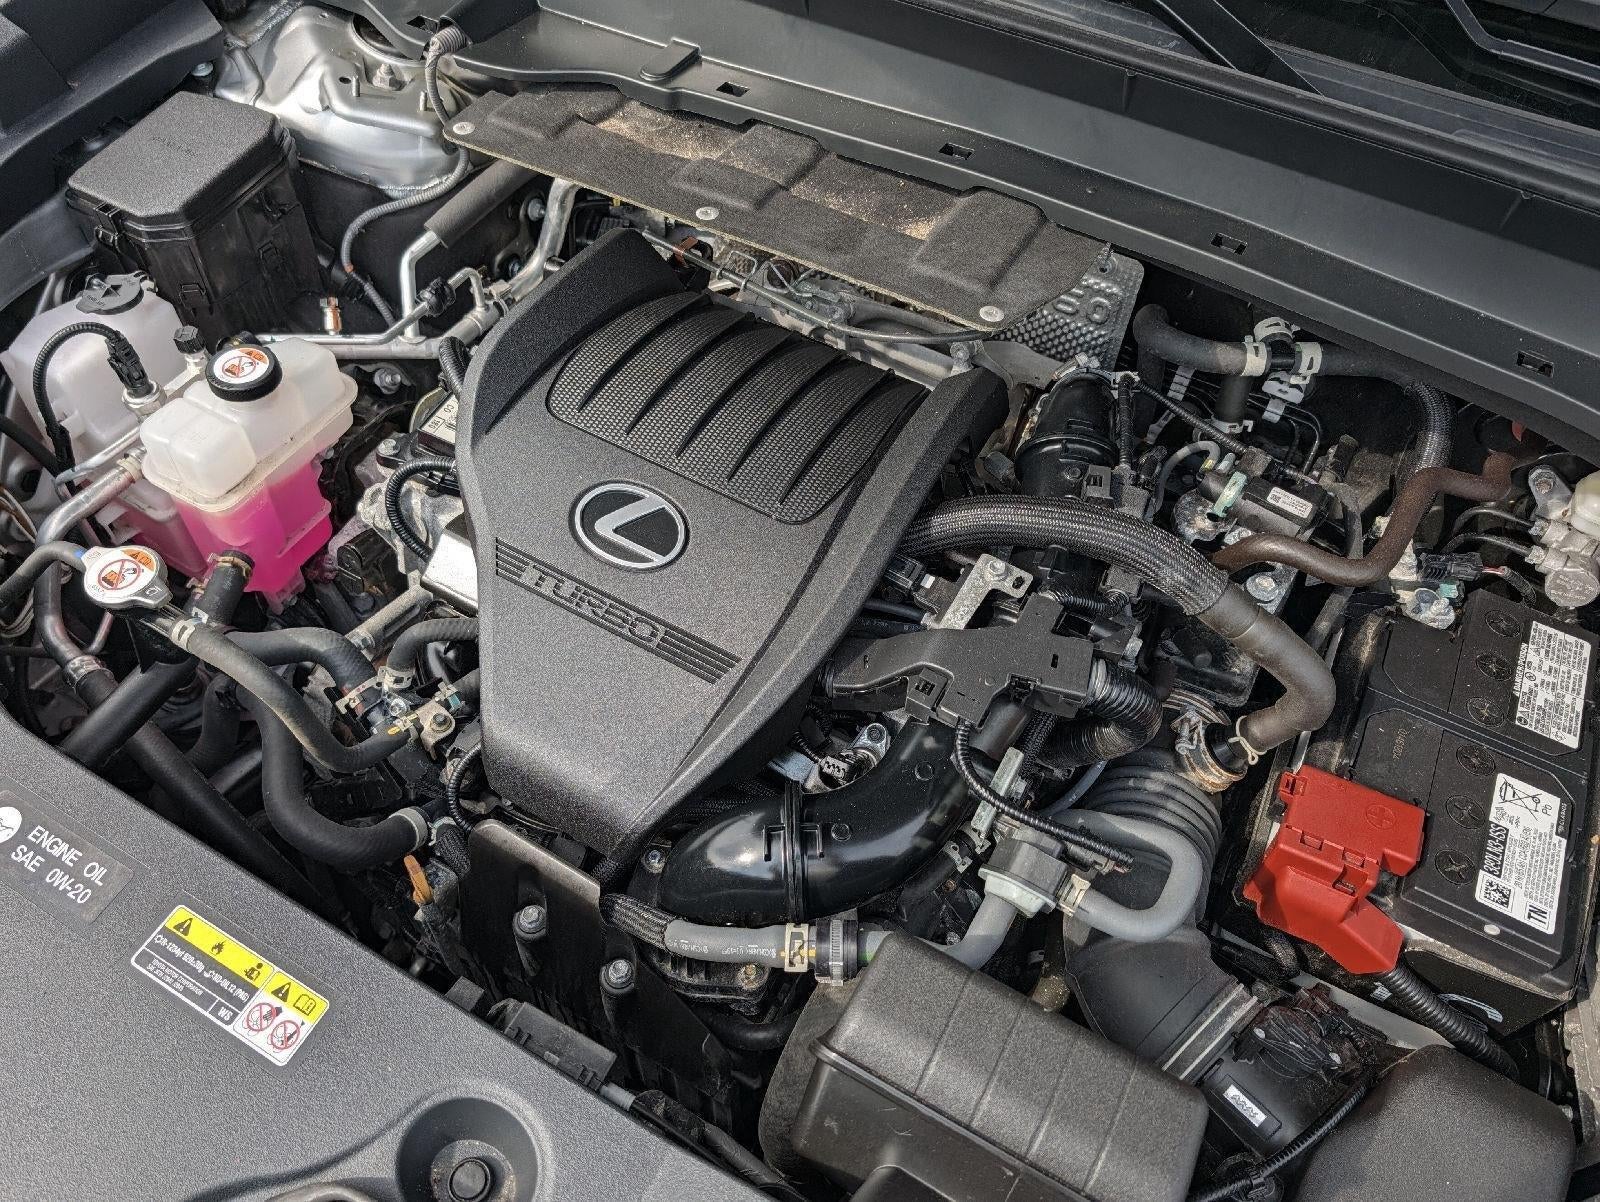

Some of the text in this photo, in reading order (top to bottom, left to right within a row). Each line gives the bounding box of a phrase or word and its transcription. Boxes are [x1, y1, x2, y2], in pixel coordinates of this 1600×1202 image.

[531, 565, 662, 644] TURBO
[1542, 804, 1553, 817] Pb
[10, 844, 92, 904] SAE 0W-20
[27, 824, 108, 887] ENGINE OIL
[1527, 904, 1548, 925] TN
[217, 1006, 234, 1022] WS
